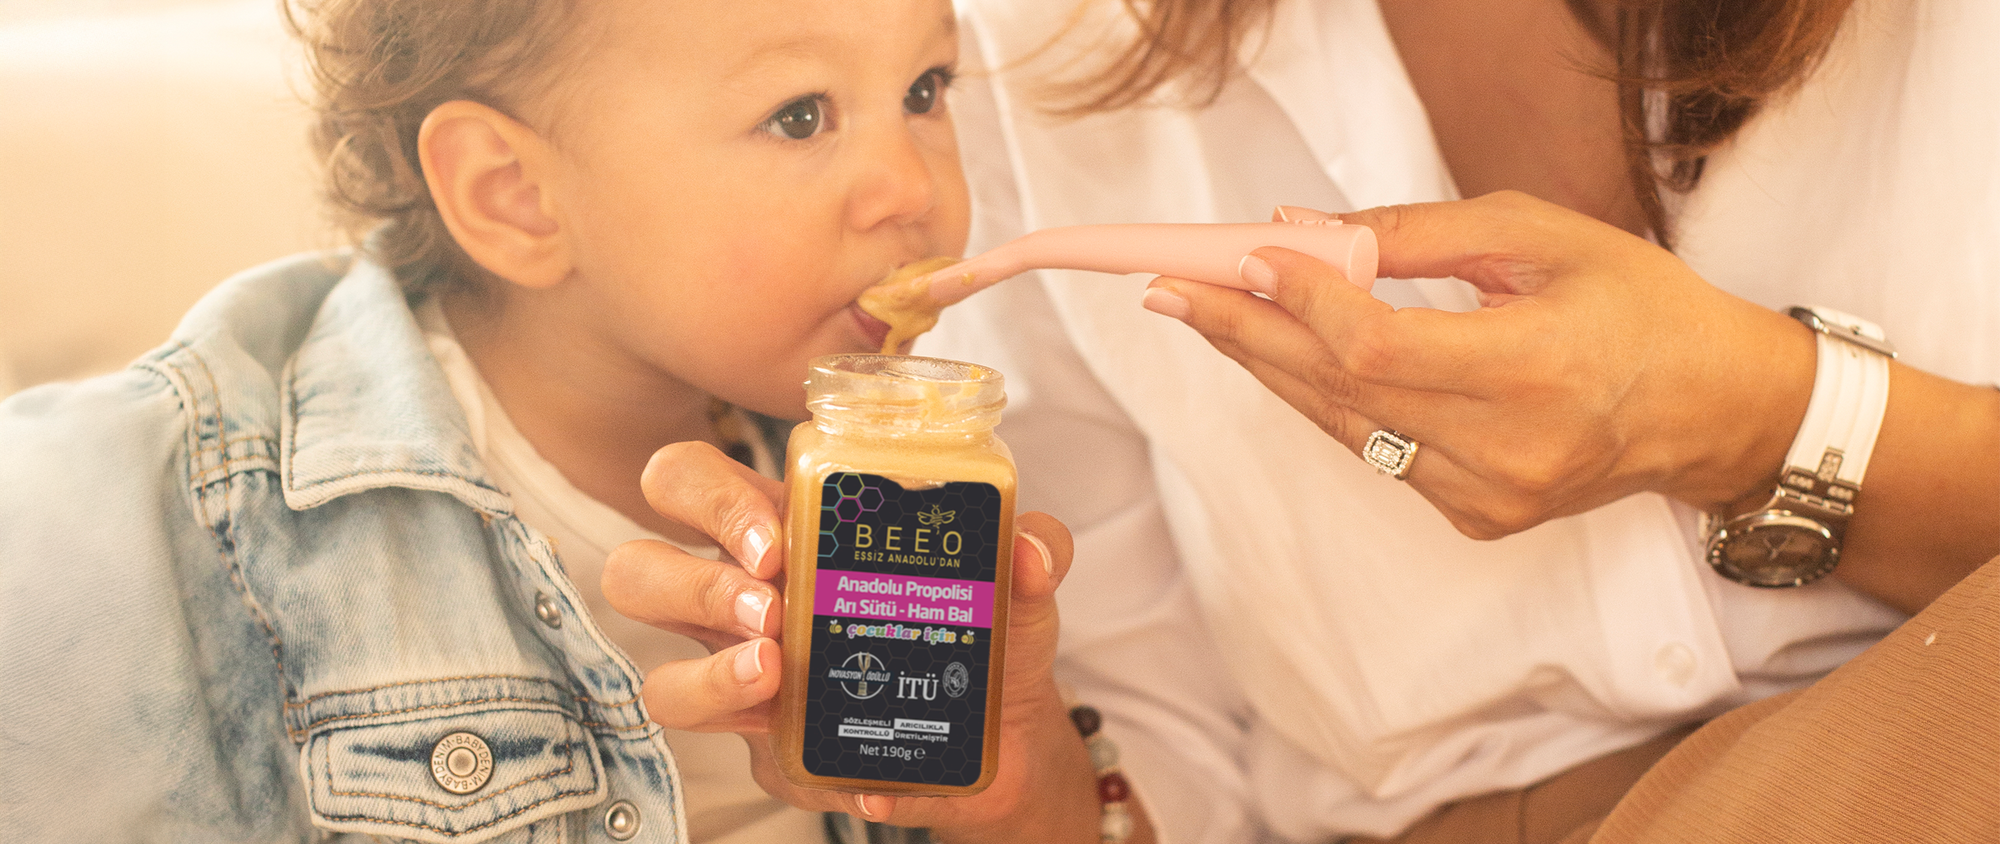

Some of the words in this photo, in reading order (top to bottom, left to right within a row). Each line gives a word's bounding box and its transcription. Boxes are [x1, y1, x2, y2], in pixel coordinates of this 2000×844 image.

[855, 524, 962, 555] BEEO
[854, 550, 884, 562] EŞSİZ
[887, 553, 961, 568] ANADOLU'DAN
[837, 575, 903, 596] Anadolu
[905, 581, 973, 602] Propolisi
[833, 597, 857, 614] Arı
[859, 599, 897, 617] Sütü
[907, 603, 945, 620] Ham
[948, 606, 973, 623] Bal
[847, 624, 921, 640] çocuklar
[923, 626, 957, 645] için
[896, 671, 939, 701] İTÜ
[843, 717, 891, 727] SÖZLEŞMELİ
[843, 728, 890, 737] KONTROLLÜ
[894, 731, 948, 743] ÜRETİLMİŞTİR
[859, 744, 880, 756] Net
[882, 746, 912, 761] 190g
